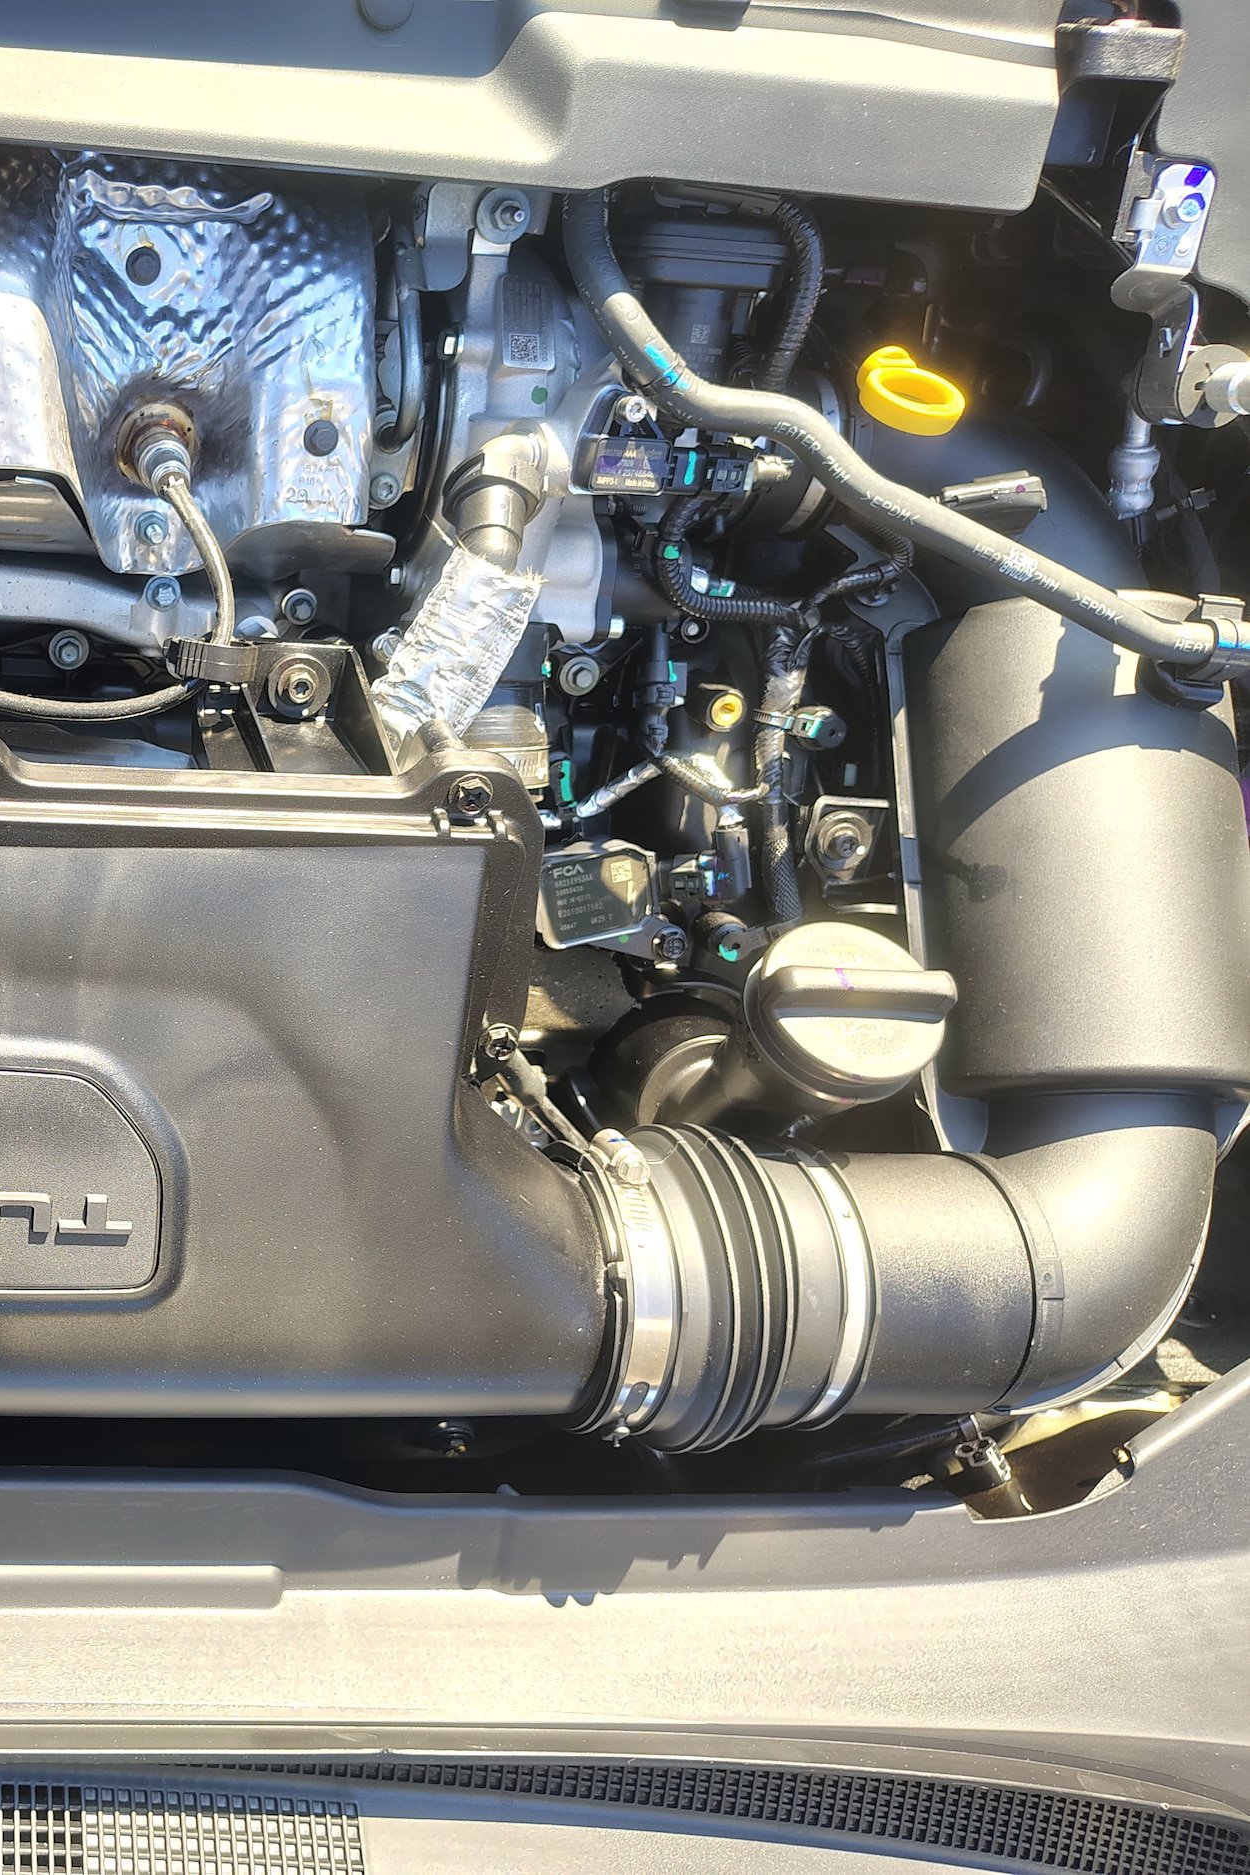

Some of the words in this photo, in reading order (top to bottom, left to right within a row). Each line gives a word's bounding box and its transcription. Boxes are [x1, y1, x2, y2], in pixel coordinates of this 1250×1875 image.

[1070, 591, 1125, 626] >EPDM<
[1173, 637, 1213, 655] HEAT
[553, 863, 585, 879] FCA
